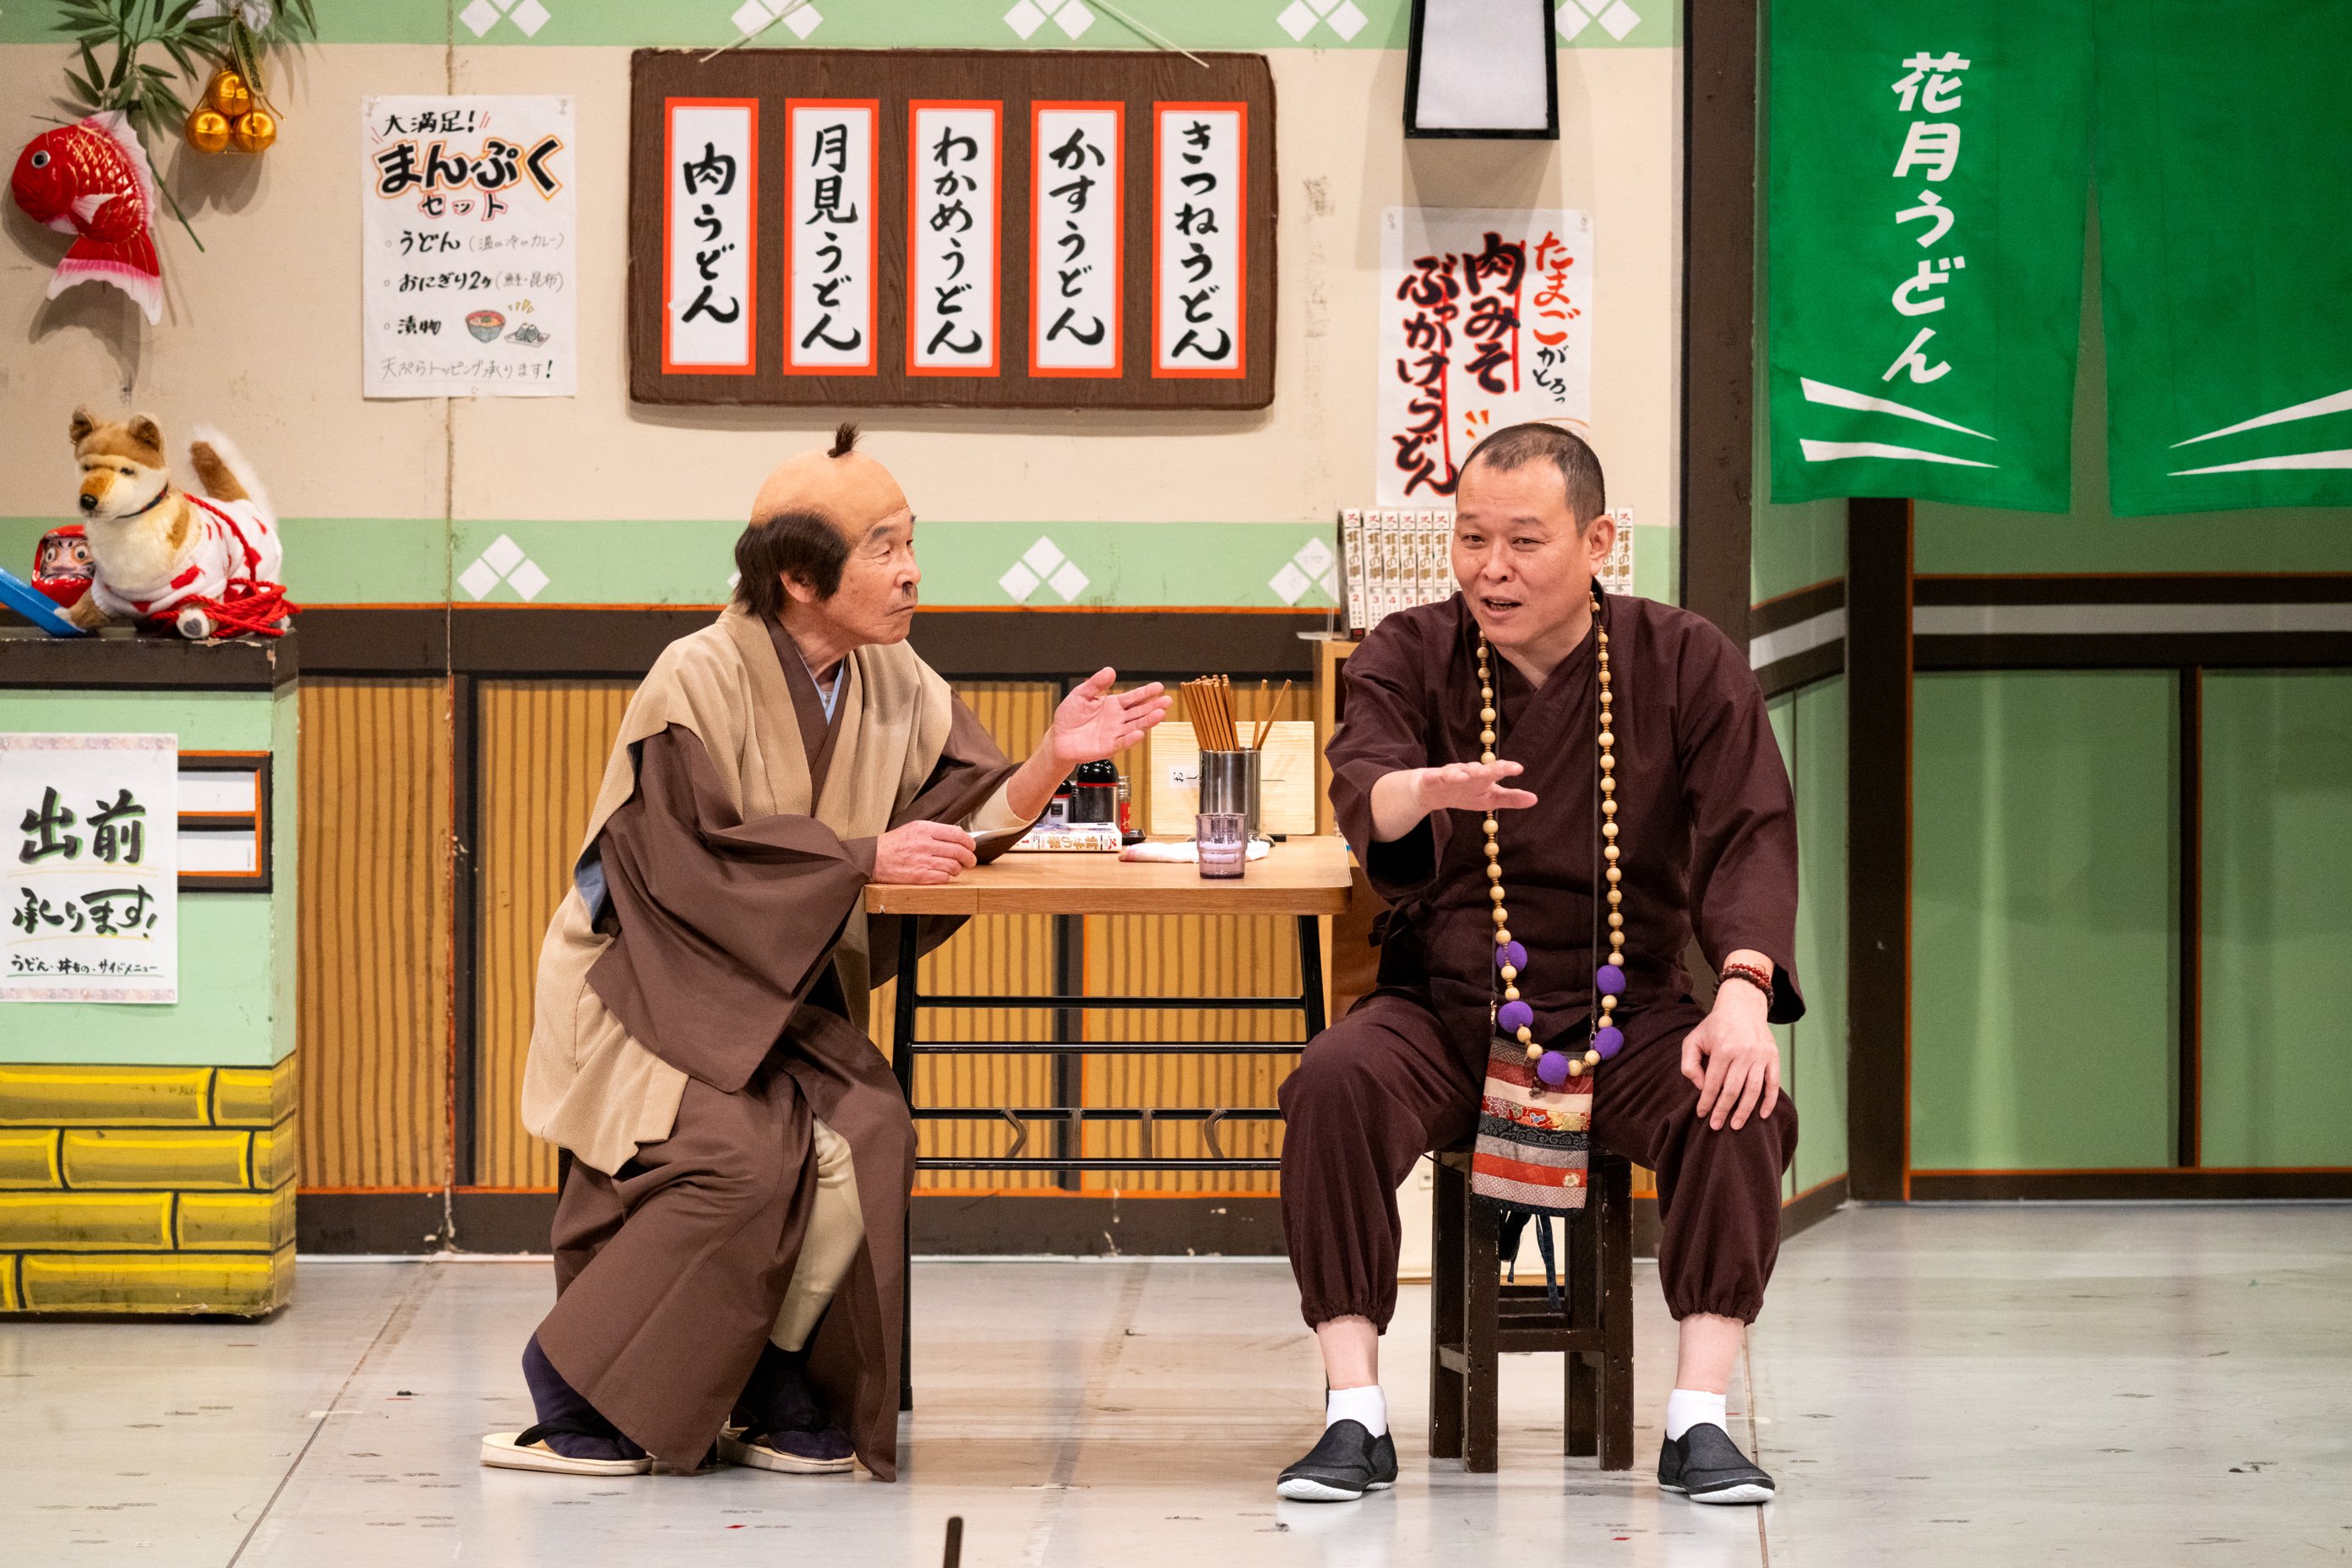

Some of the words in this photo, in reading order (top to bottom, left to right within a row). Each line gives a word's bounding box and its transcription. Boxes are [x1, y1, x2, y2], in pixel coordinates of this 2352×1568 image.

[377, 138, 559, 196] まんぷく
[384, 110, 476, 136] 大満足!
[421, 193, 505, 219] セット
[400, 230, 460, 255] うどん
[681, 142, 740, 324] 肉うどん
[802, 123, 862, 351] 月見うどん
[927, 126, 983, 355] わかめうどん
[1046, 128, 1105, 346] かすうどん
[1171, 121, 1231, 361] きつねうどん
[1882, 52, 1970, 384] 花月うどん
[397, 315, 442, 335] 漬物
[1392, 253, 1461, 497] ぶっかけうどん
[1462, 231, 1527, 395] 肉みそ
[19, 786, 147, 864] 出前
